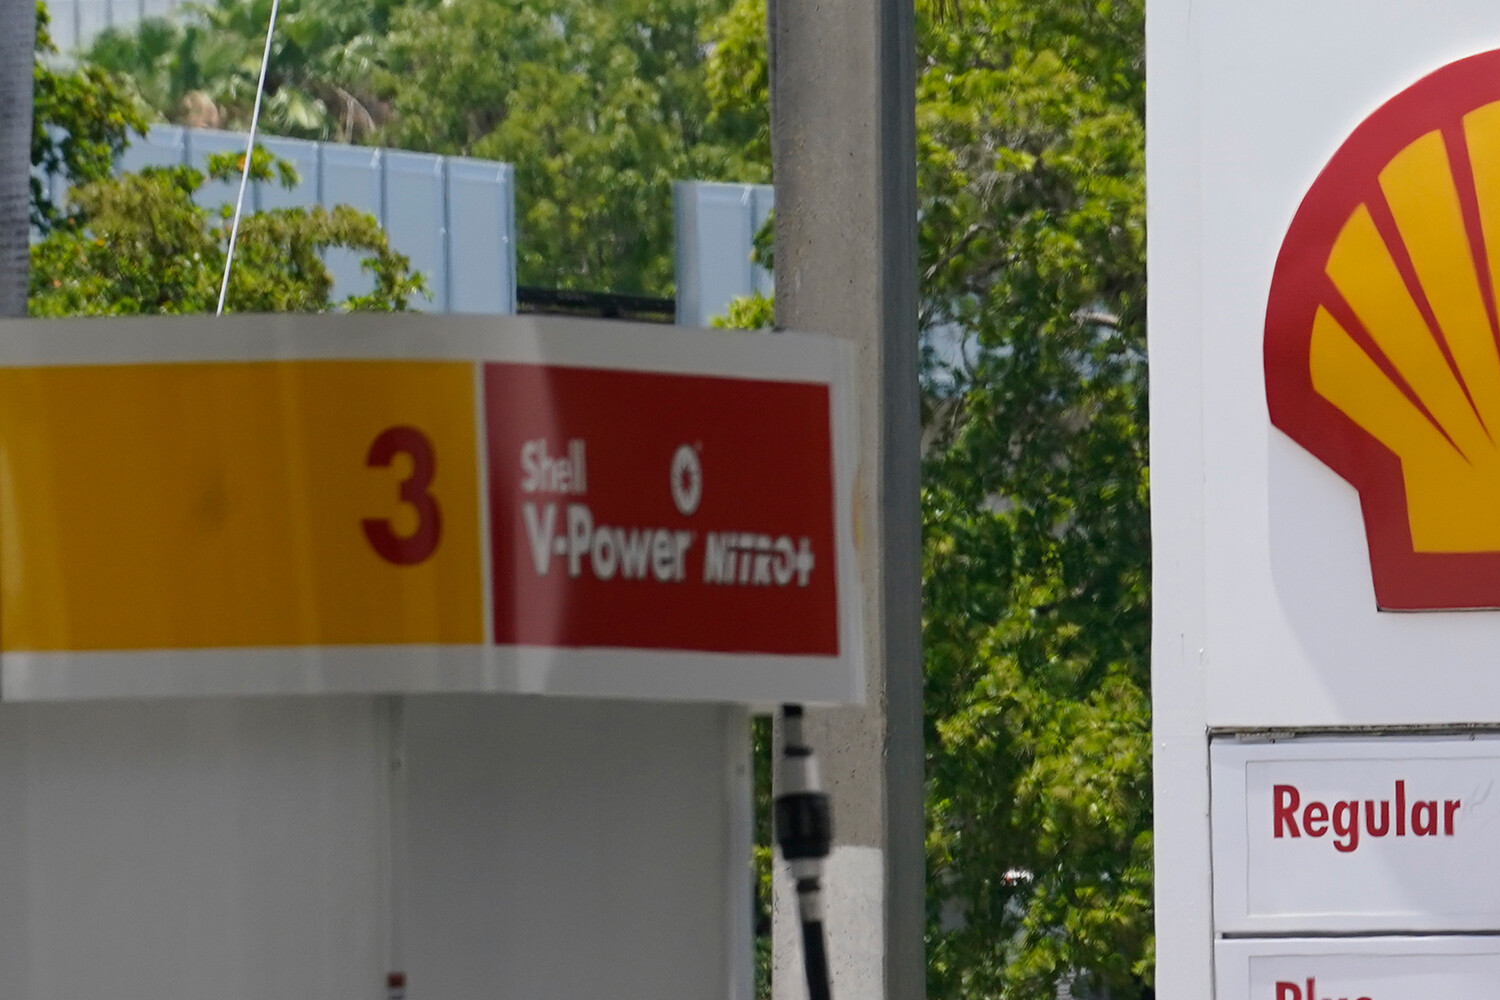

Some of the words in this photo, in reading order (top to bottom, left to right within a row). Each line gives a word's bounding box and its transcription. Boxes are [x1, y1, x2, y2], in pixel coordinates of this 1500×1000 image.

[361, 425, 443, 567] 3
[520, 438, 587, 495] Shell
[523, 502, 692, 583] V-Power
[1272, 779, 1461, 853] Regular
